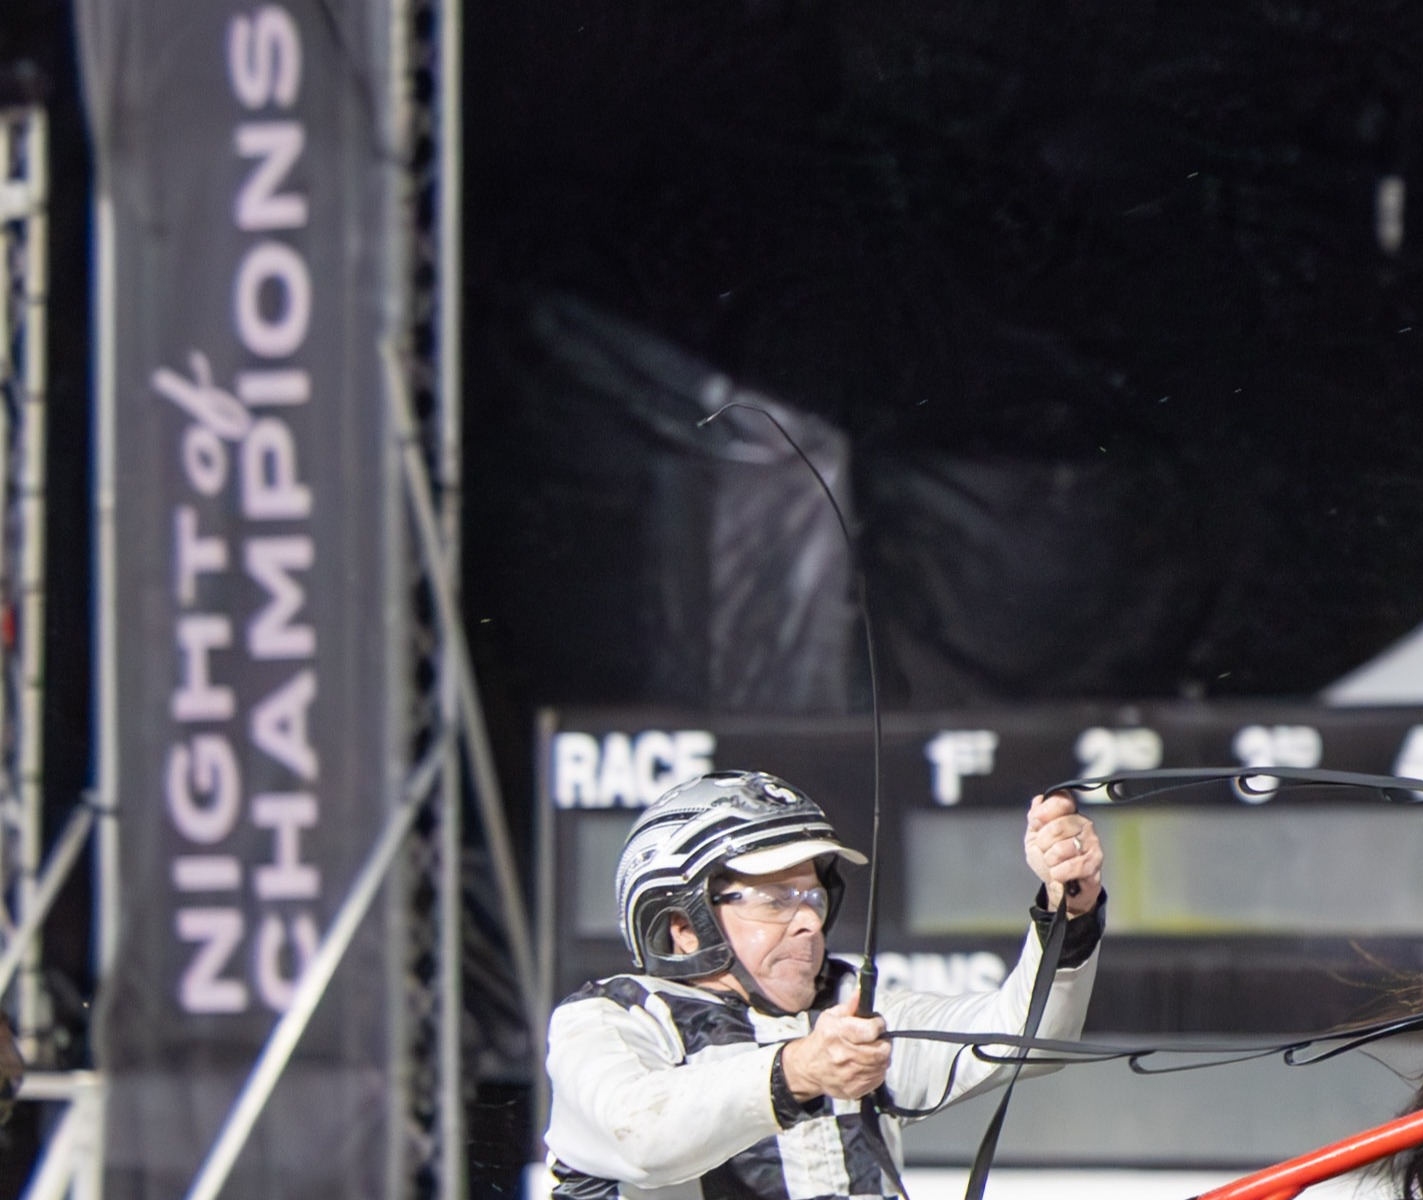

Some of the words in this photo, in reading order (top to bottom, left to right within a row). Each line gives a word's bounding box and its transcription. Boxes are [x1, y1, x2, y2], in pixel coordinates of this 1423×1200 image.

[151, 351, 255, 498] of
[229, 3, 321, 1015] CHAMPIONS
[166, 505, 248, 1014] NIGHT
[554, 730, 717, 809] RACE
